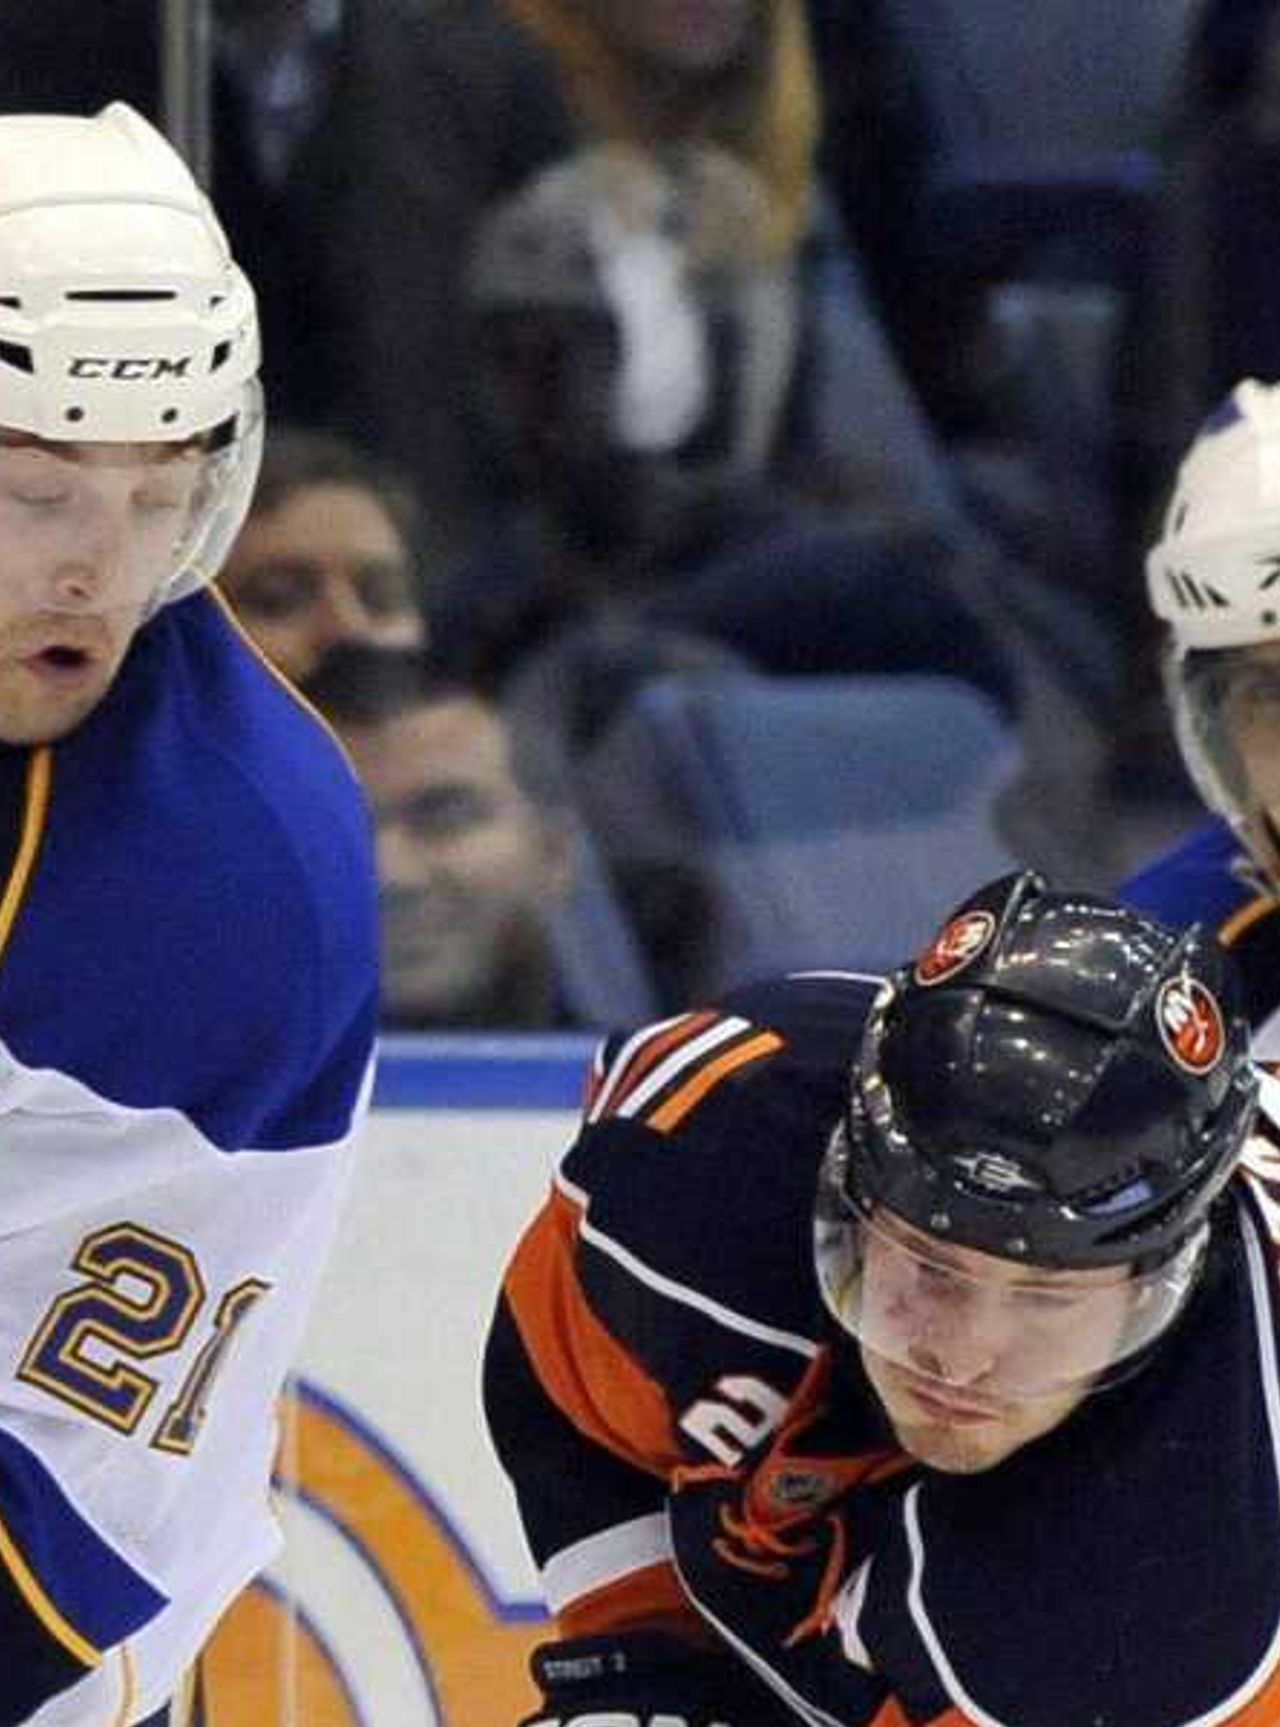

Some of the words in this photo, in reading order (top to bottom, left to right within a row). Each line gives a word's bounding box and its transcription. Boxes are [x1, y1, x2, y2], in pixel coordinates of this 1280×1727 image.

[67, 356, 191, 379] CCM
[16, 1221, 273, 1456] 21
[678, 1374, 790, 1469] 2
